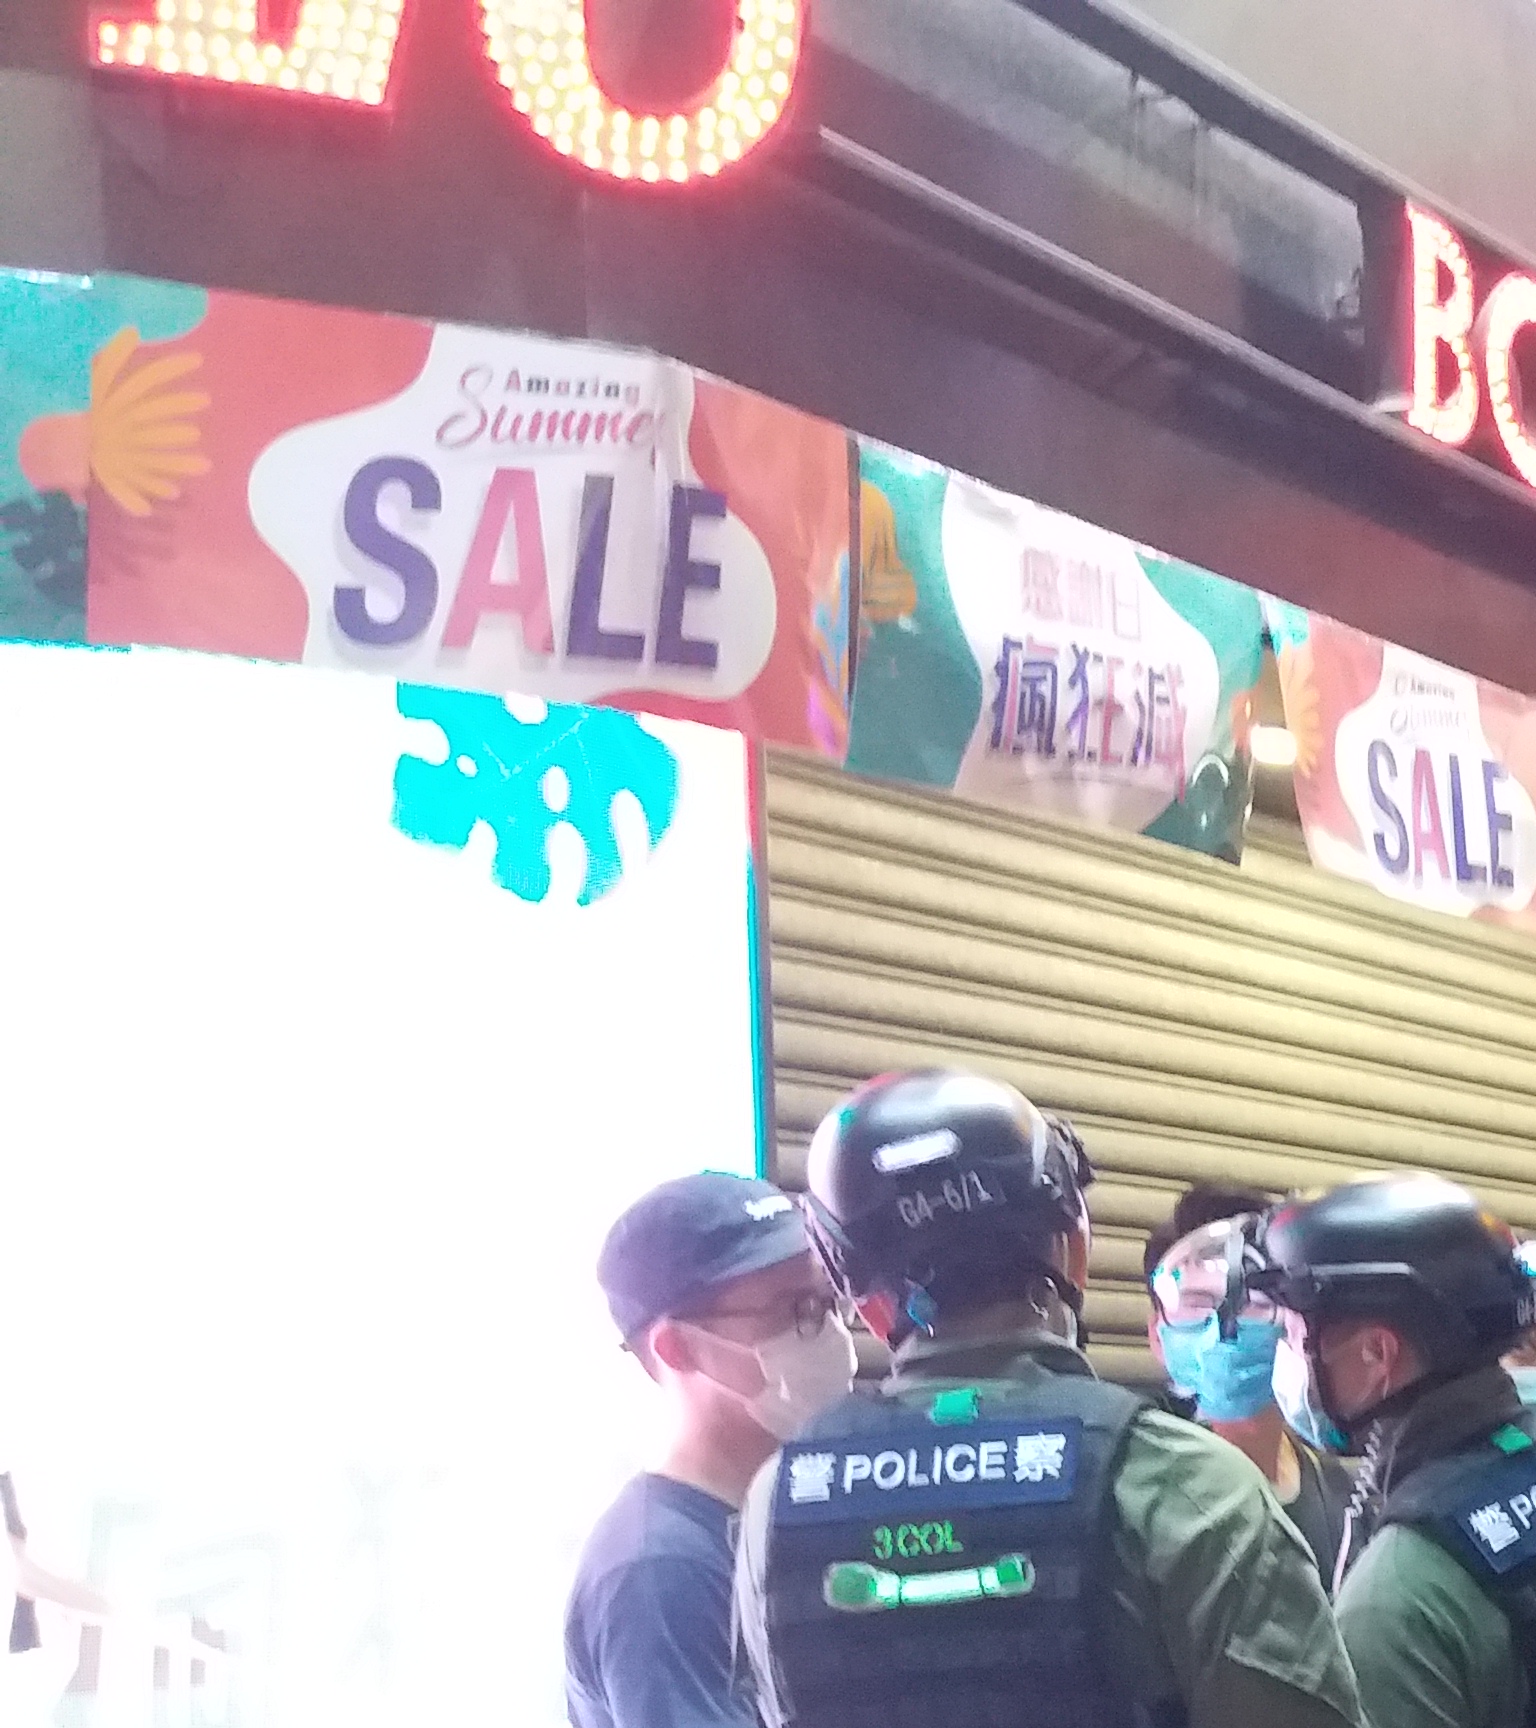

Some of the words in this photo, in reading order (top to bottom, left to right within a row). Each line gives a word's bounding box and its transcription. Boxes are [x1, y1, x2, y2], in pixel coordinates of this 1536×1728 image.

[505, 367, 640, 406] Amazing
[332, 455, 727, 674] SALE
[1367, 738, 1515, 890] SALE
[842, 1440, 1008, 1494] POLICE
